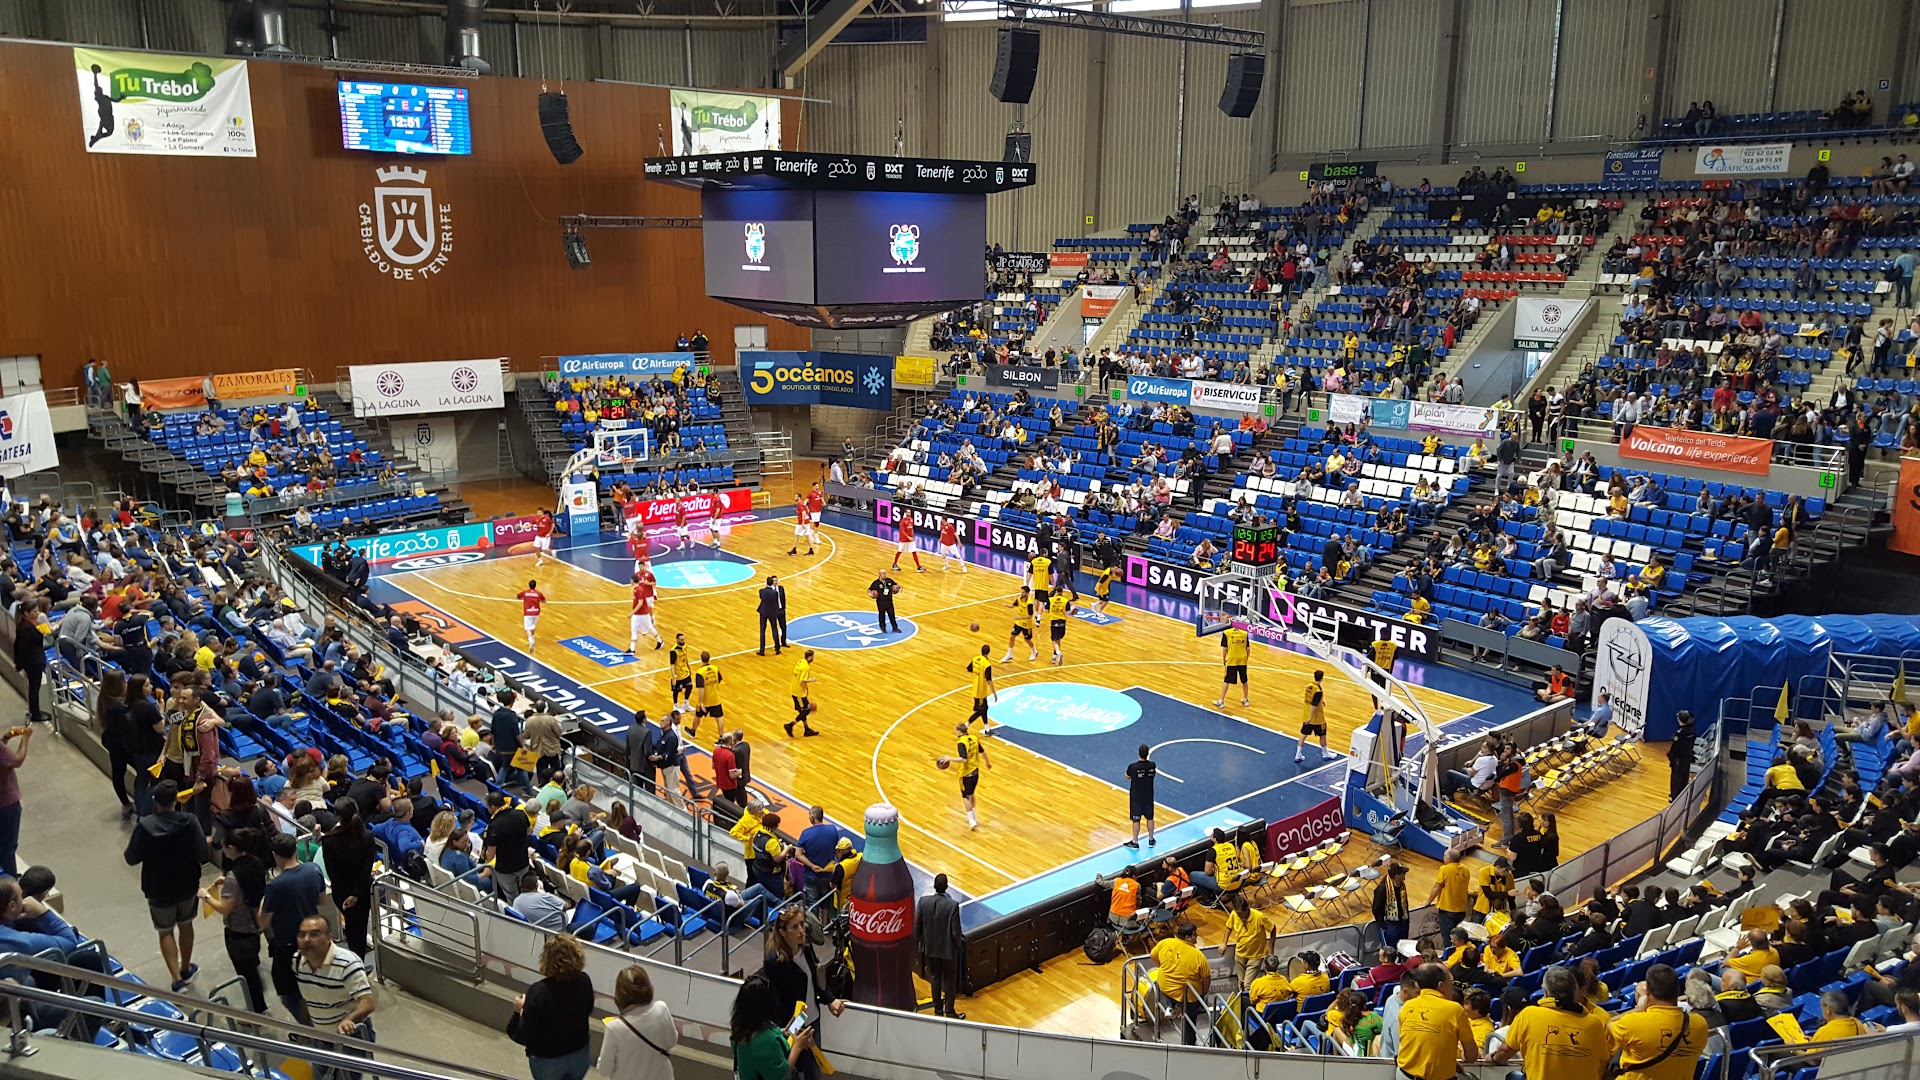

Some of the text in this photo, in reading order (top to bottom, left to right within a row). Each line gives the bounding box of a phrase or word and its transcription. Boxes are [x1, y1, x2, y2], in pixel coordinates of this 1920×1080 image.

[115, 73, 200, 96] Tu Trébol
[389, 115, 421, 129] 12:51
[694, 109, 748, 127] Tu Trébol
[644, 162, 662, 175] Tenerife
[702, 158, 722, 172] Tenerife
[774, 157, 818, 176] Tenerife
[828, 159, 857, 178] 2030
[885, 163, 904, 173] DXT
[916, 164, 955, 182] Tenerife
[962, 165, 988, 183] 2030
[1011, 168, 1029, 177] DXT
[359, 202, 453, 280] CABILDO DE TENERIFE
[1008, 258, 1045, 269] CUADROS
[1517, 340, 1539, 349] SALIDA
[582, 360, 624, 370] AirEuropa
[650, 358, 691, 368] AirEuropa
[217, 371, 292, 388] ZAMORALES
[750, 361, 855, 395] 5 océanos
[1002, 370, 1042, 382] SILBON
[822, 385, 854, 393] CONGELADOS
[1147, 384, 1188, 398] AirEuropa
[1203, 387, 1258, 401] BISERVICUS
[364, 399, 421, 410] LA LAGUNA
[439, 394, 494, 406] LA LAGUNA
[611, 407, 625, 419] 24
[1664, 433, 1727, 448] Teleférico del Teide
[1629, 436, 1759, 465] Volcano life experience
[645, 497, 712, 520] fuenealta
[495, 521, 538, 536] endes
[1237, 529, 1257, 540] 12:51
[394, 532, 439, 558] 2030
[1235, 540, 1276, 562] 24 24
[409, 554, 468, 569] KIA
[1247, 624, 1283, 642] endesa
[1276, 806, 1344, 852] endesa
[849, 901, 907, 935] Coca-Cola
